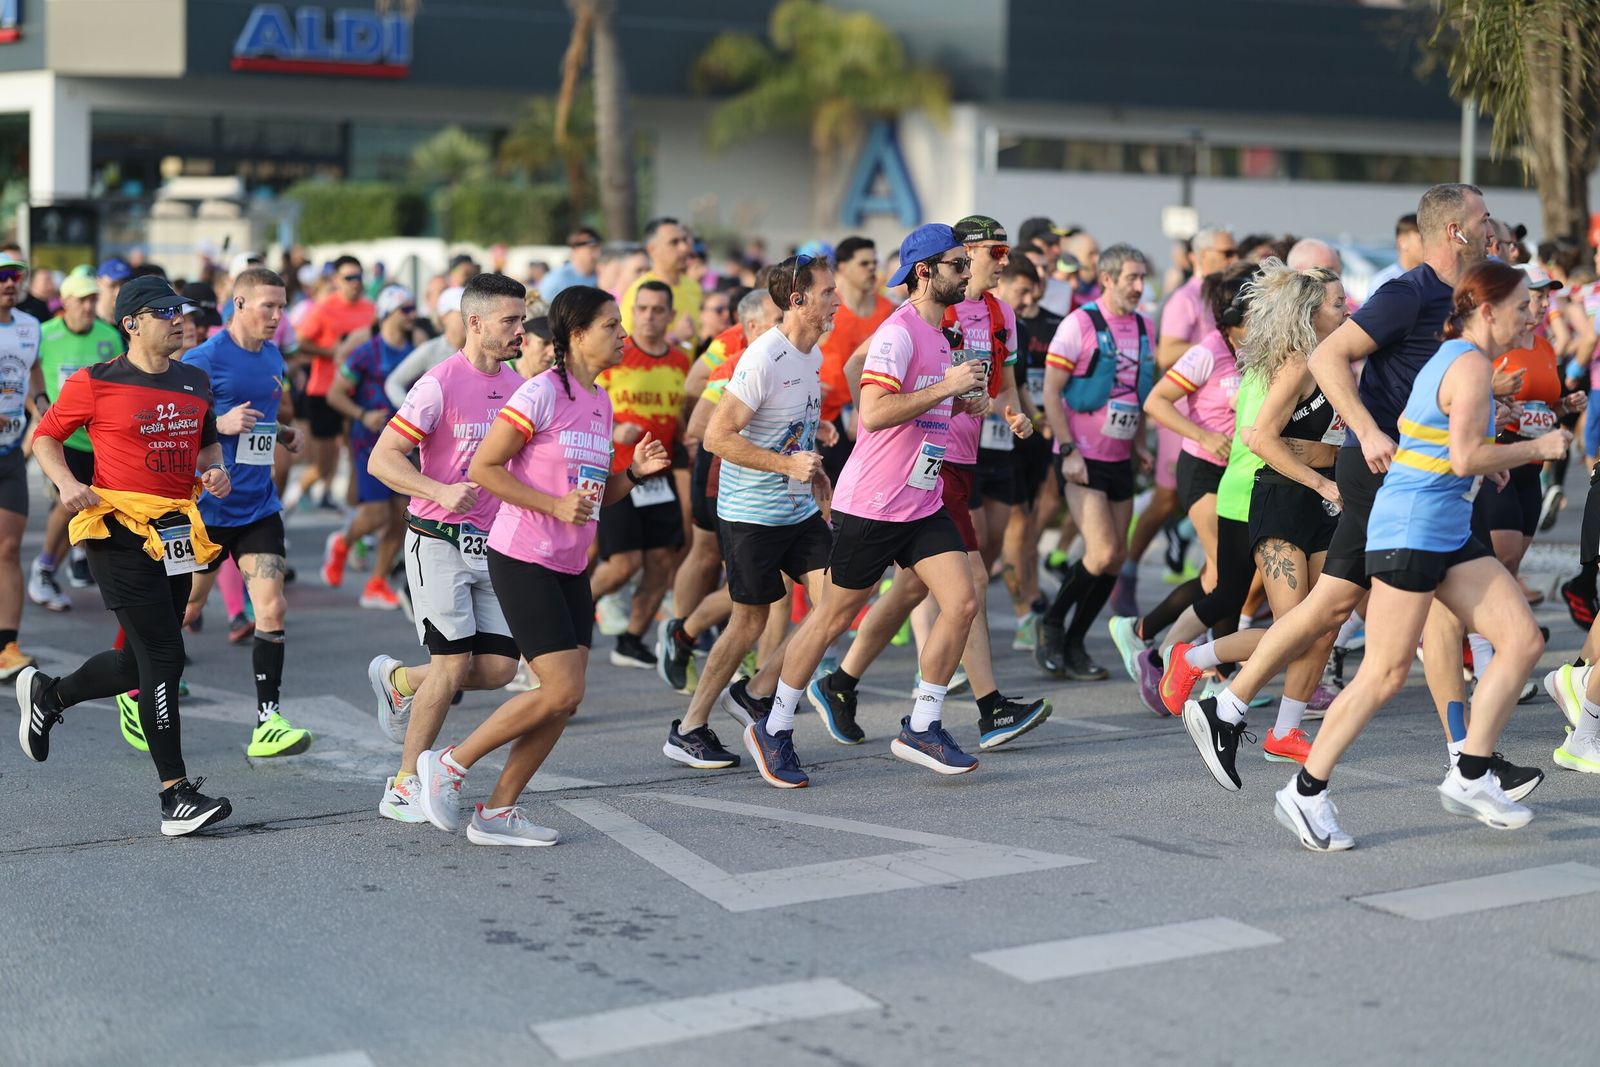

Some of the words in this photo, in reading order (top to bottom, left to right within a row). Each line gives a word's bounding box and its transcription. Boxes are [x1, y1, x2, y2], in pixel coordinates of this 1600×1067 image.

[234, 4, 412, 66] ALDI
[156, 402, 180, 421] 22
[148, 440, 176, 450] CIUDAD
[179, 441, 189, 449] DE
[248, 434, 272, 452] 108
[559, 430, 594, 449] MEDIA
[145, 449, 193, 473] GETAFE
[993, 715, 1015, 727] HOKA
